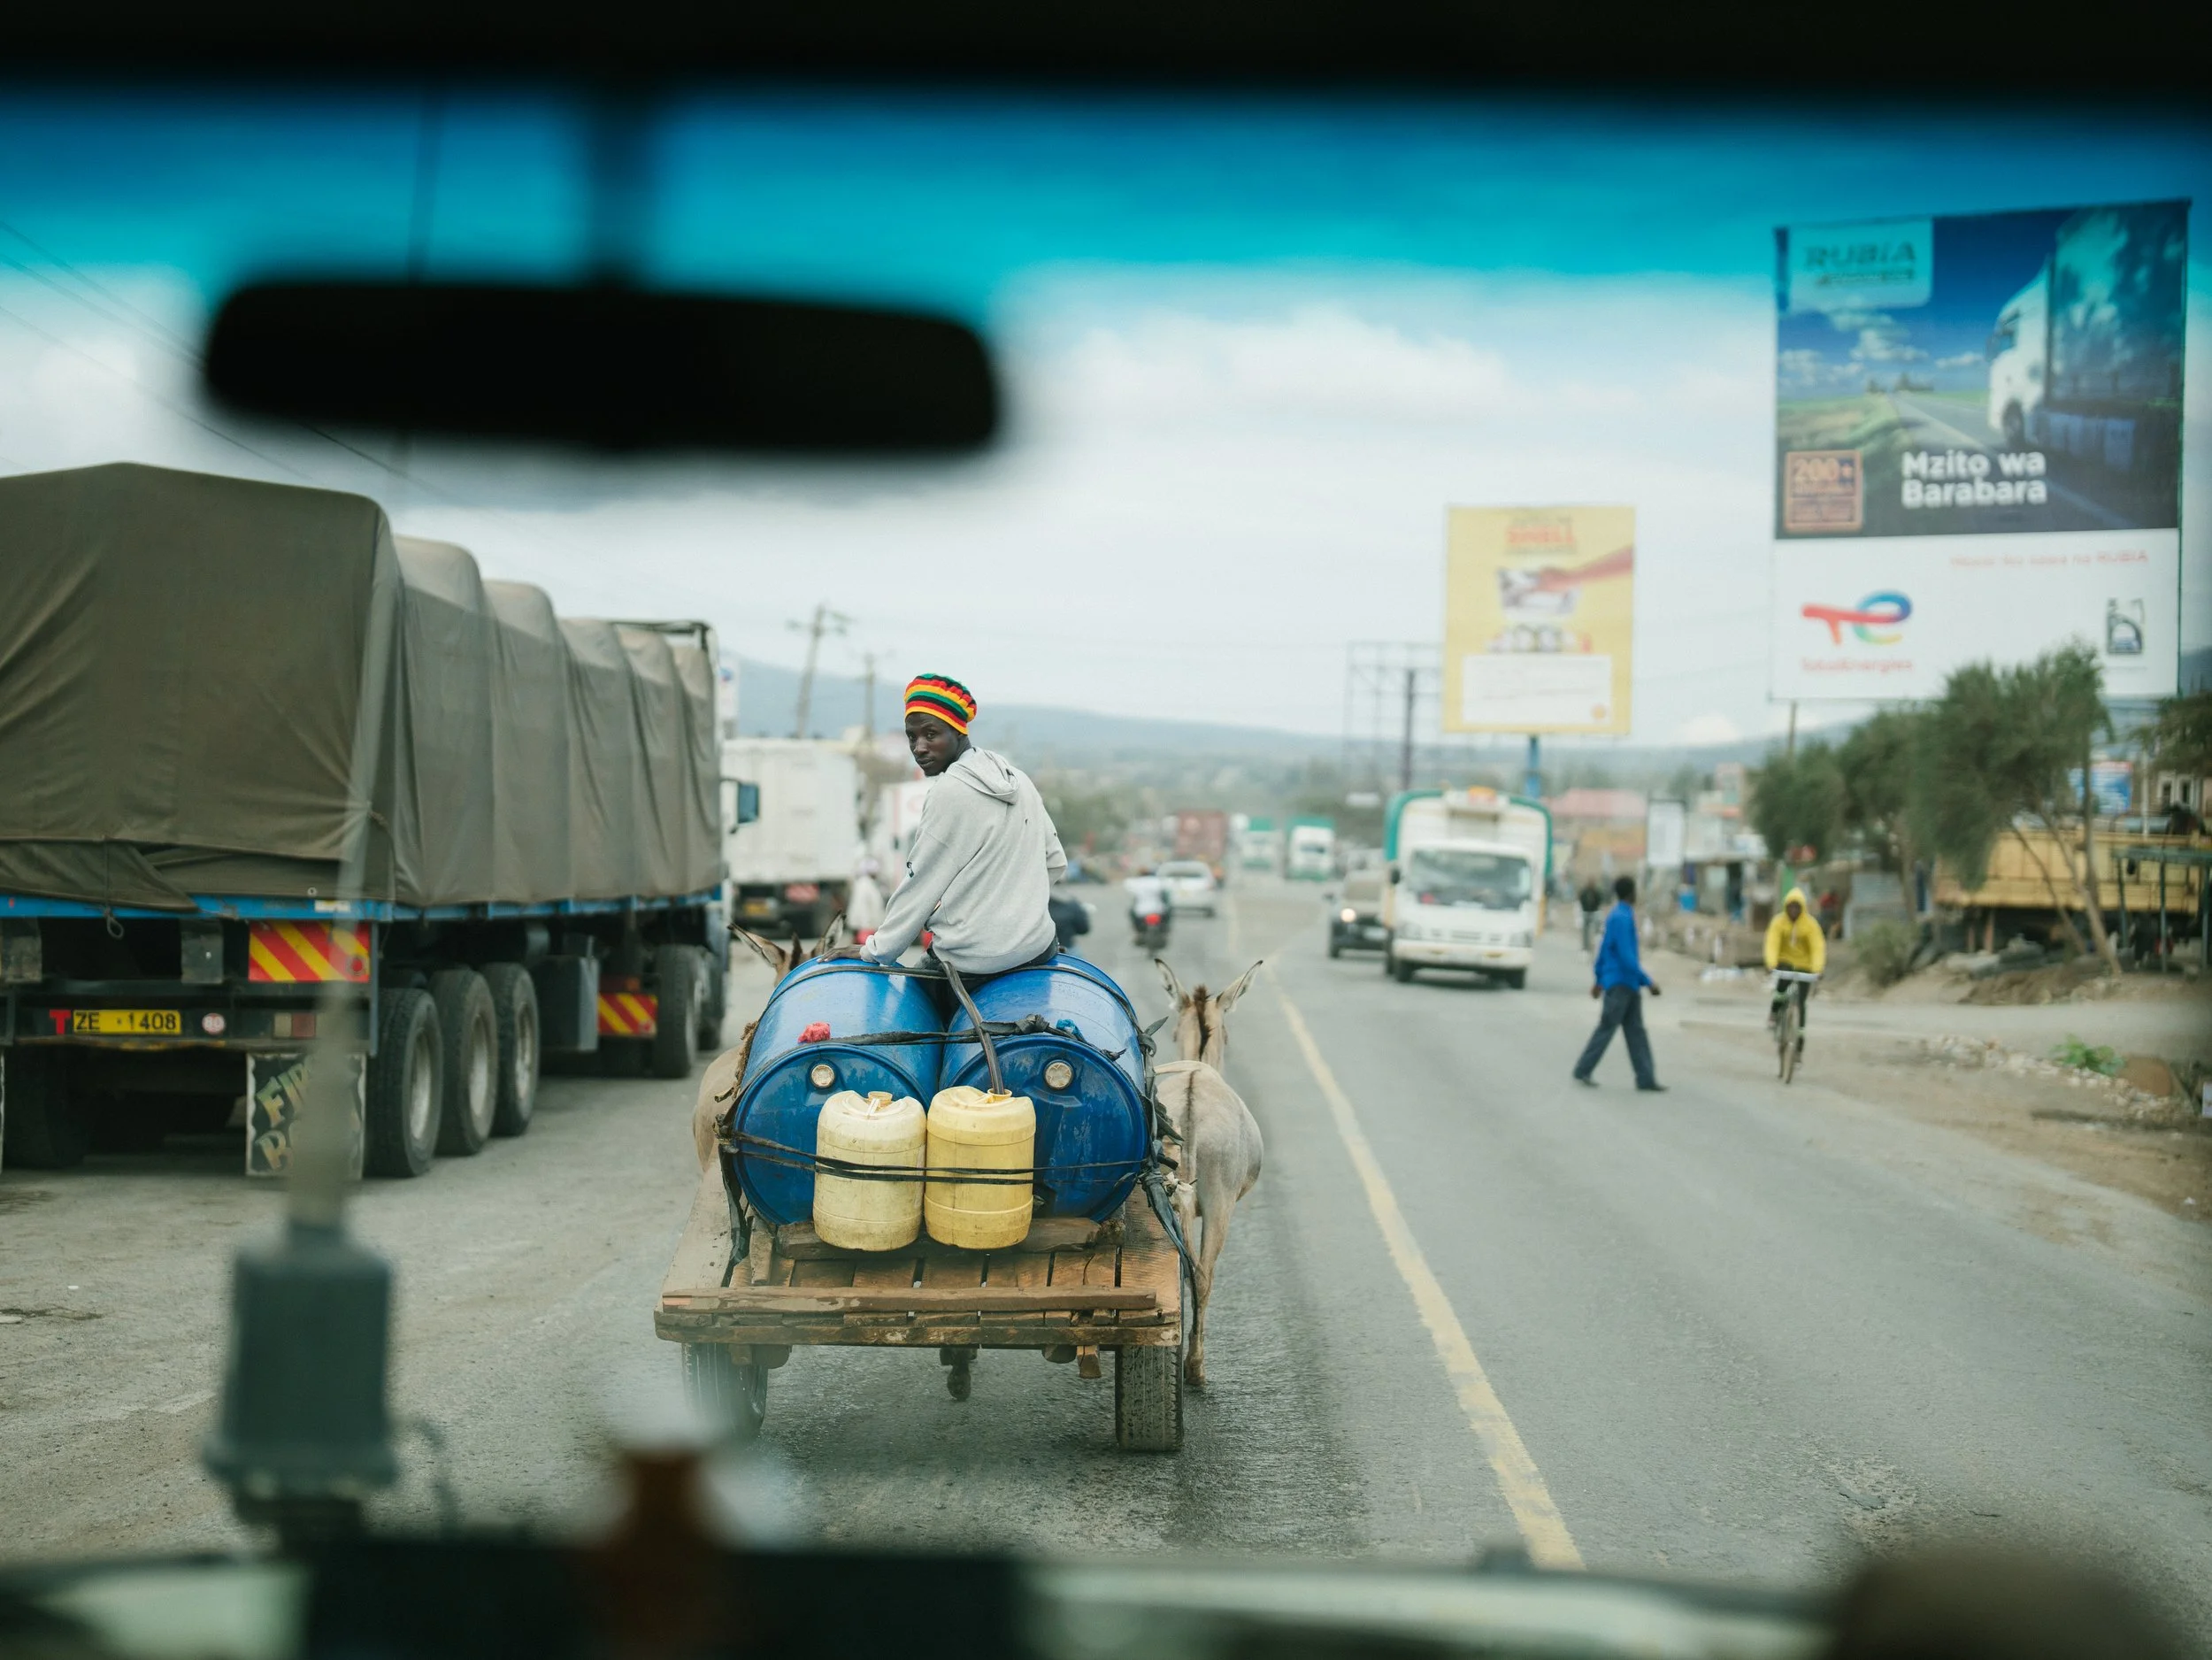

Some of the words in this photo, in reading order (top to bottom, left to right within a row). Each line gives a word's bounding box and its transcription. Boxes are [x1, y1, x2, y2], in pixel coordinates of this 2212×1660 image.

[1803, 241, 1916, 267] RUBIA
[1901, 449, 1990, 480] Mzito
[1997, 451, 2047, 478] wa
[1901, 476, 2047, 510] Barabara
[50, 1009, 72, 1034] T
[75, 1011, 100, 1031] ZE
[127, 1011, 177, 1031] 1408
